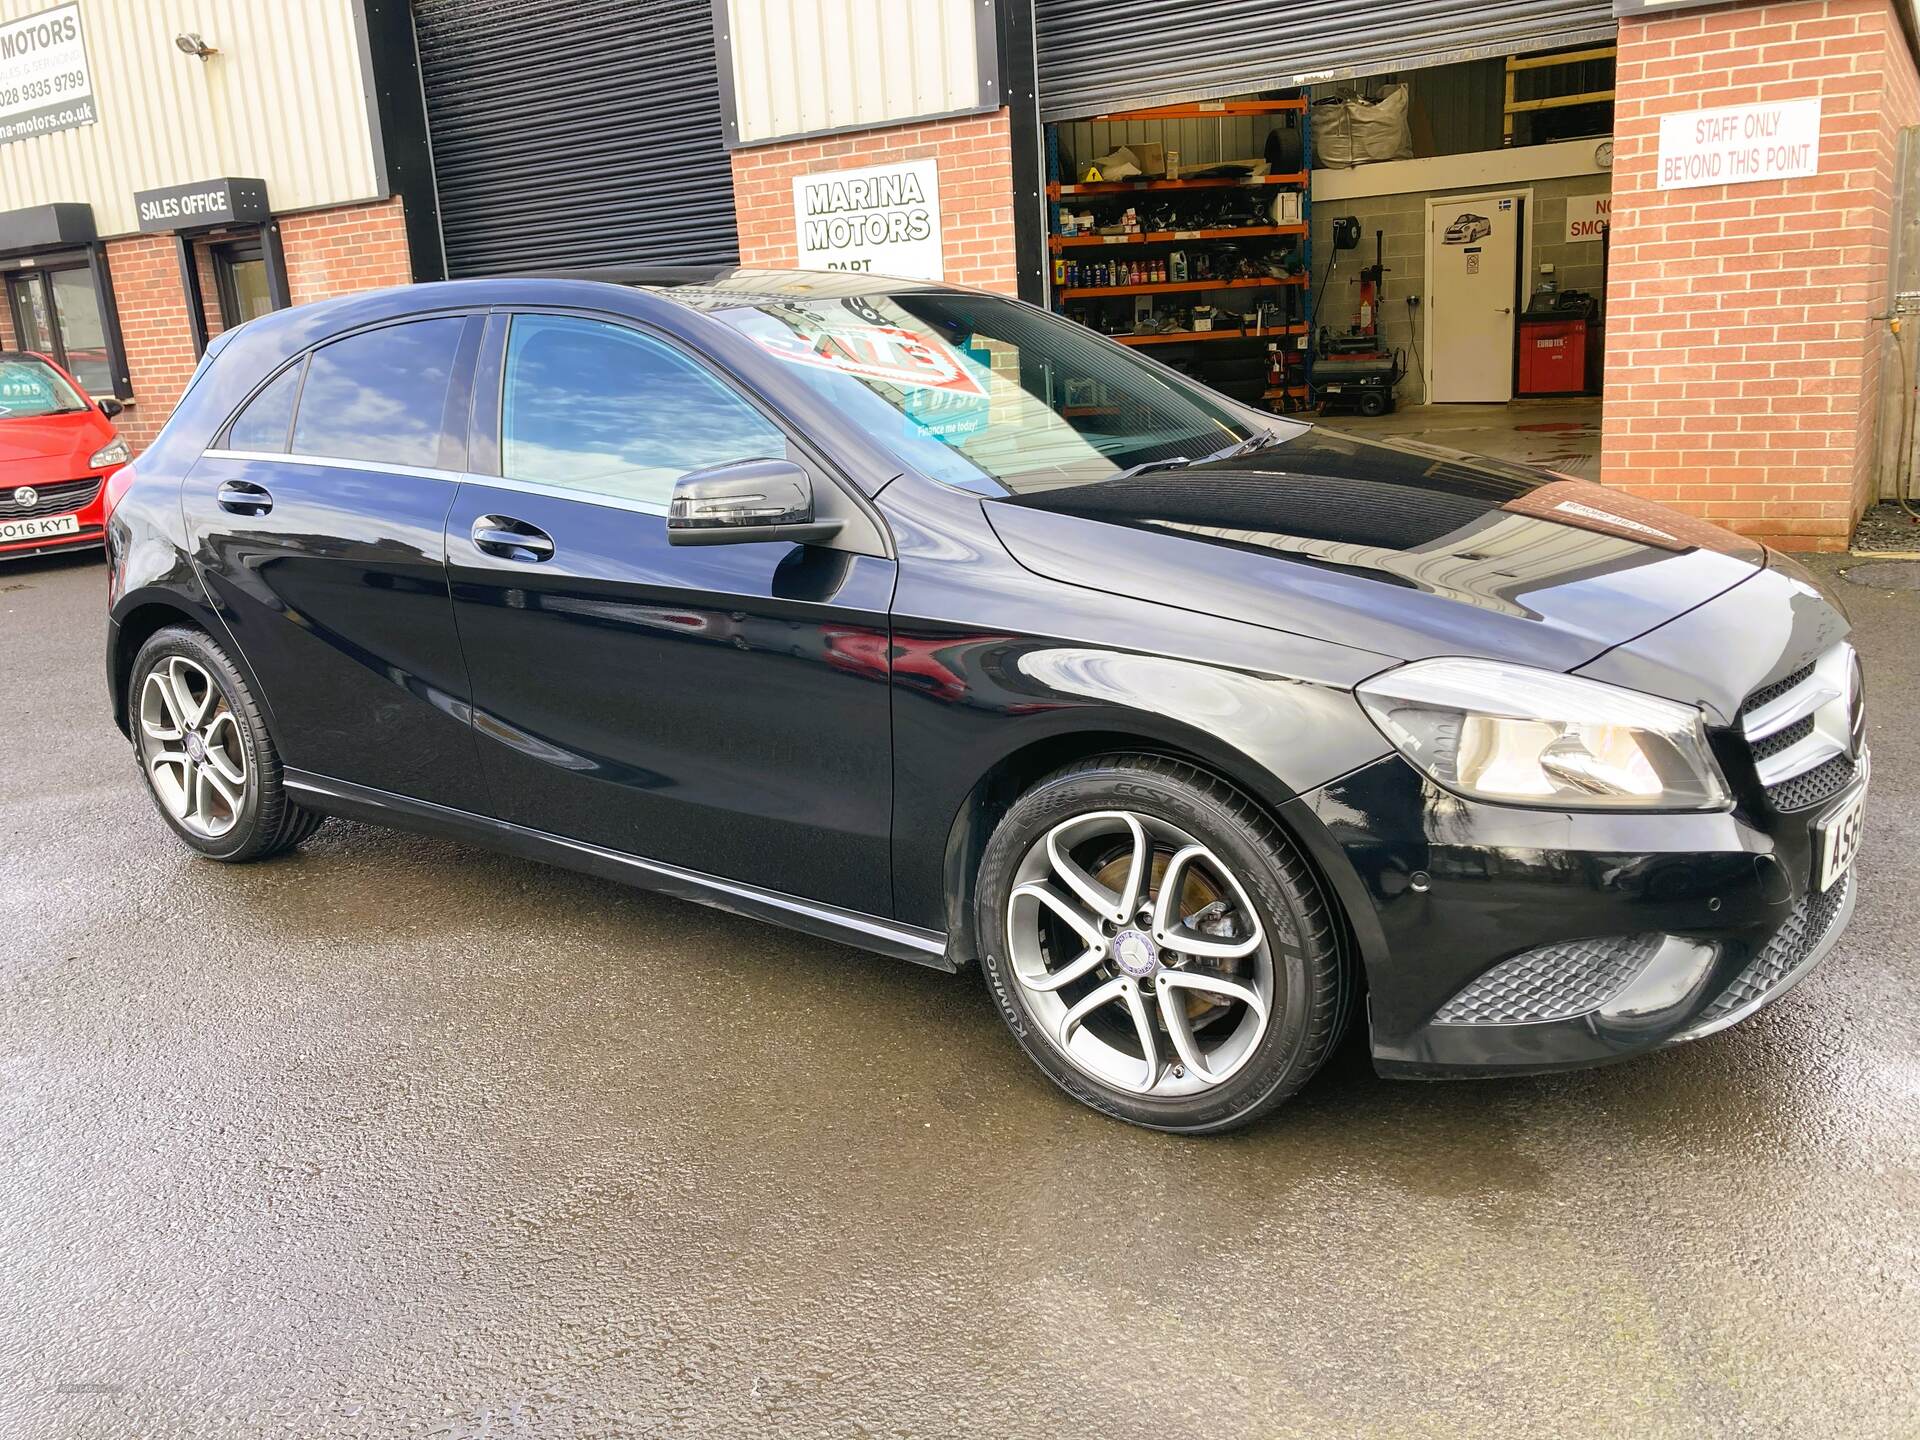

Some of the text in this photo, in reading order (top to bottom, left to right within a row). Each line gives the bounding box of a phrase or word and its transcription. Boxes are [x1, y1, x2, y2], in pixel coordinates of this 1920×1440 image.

[0, 16, 76, 60] MOTORS
[22, 79, 52, 101] 9335
[54, 70, 84, 93] 9799
[1696, 112, 1781, 145] STAFF ONLY
[1664, 144, 1811, 182] BEYOND THIS POINT
[141, 191, 228, 221] SALES OFFICE
[805, 172, 925, 216] MARINA
[804, 209, 931, 251] MOTORS
[1570, 219, 1610, 237] SMO
[946, 424, 957, 433] me
[40, 517, 73, 533] KYT
[986, 954, 1028, 1038] KUMHO
